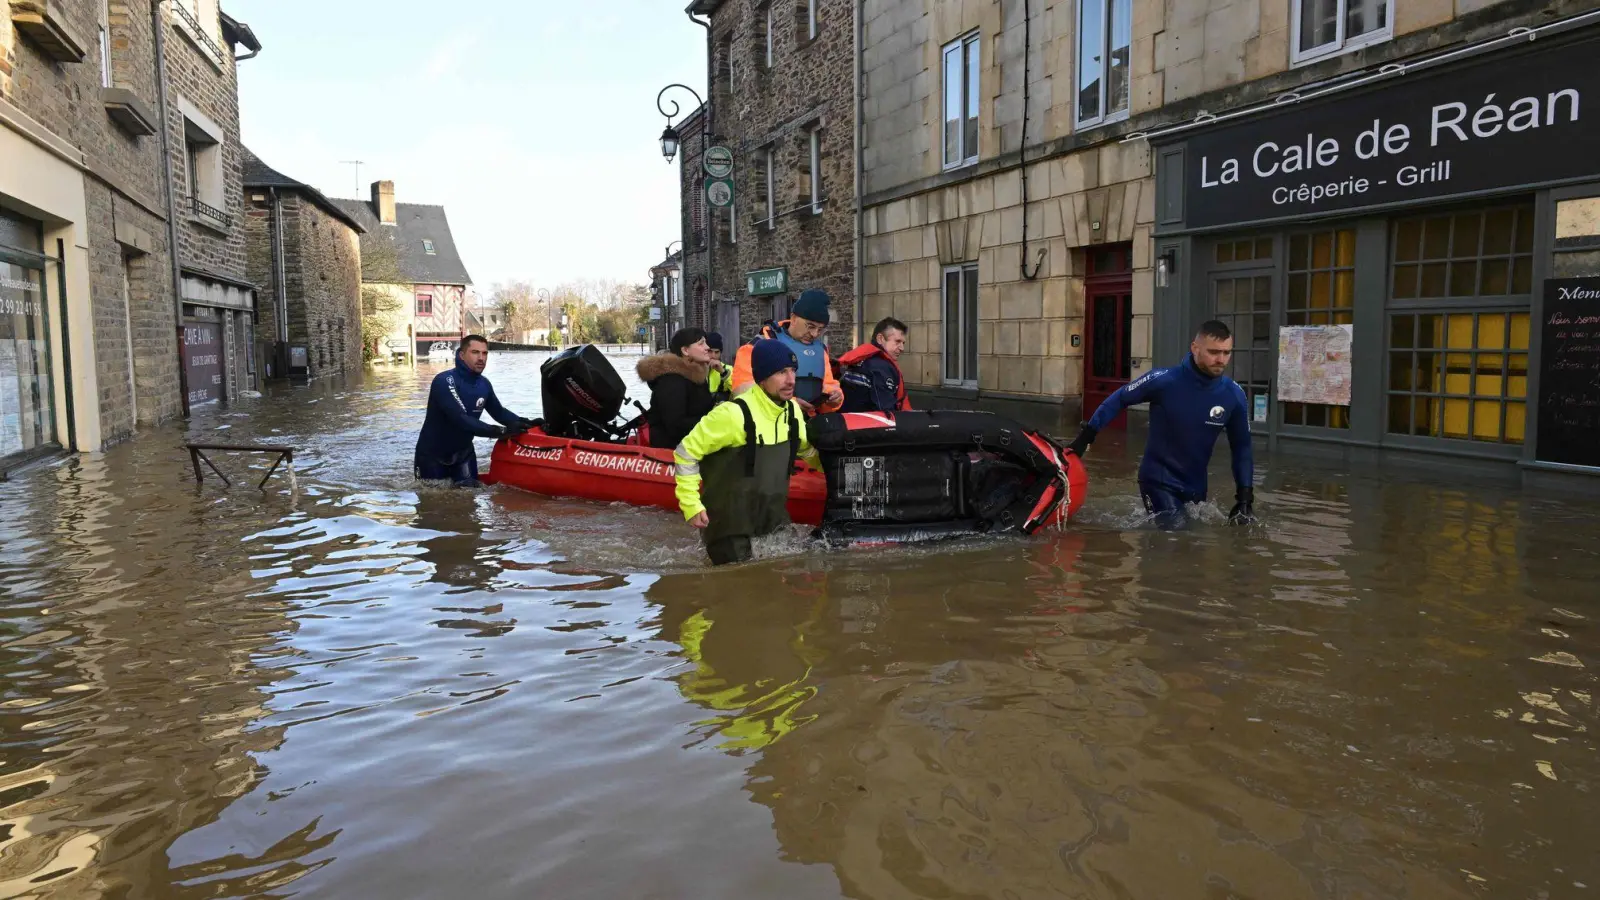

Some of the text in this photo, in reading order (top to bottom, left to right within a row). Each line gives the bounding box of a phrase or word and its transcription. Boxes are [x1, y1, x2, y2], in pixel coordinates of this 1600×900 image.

[1201, 87, 1580, 189] La Cale de Réan
[1272, 178, 1370, 206] Crêperie
[1396, 159, 1451, 187] Grill
[5, 298, 14, 315] 99
[15, 300, 24, 315] 22
[565, 377, 603, 409] MERCURY
[574, 451, 662, 476] GENDARMERIE
